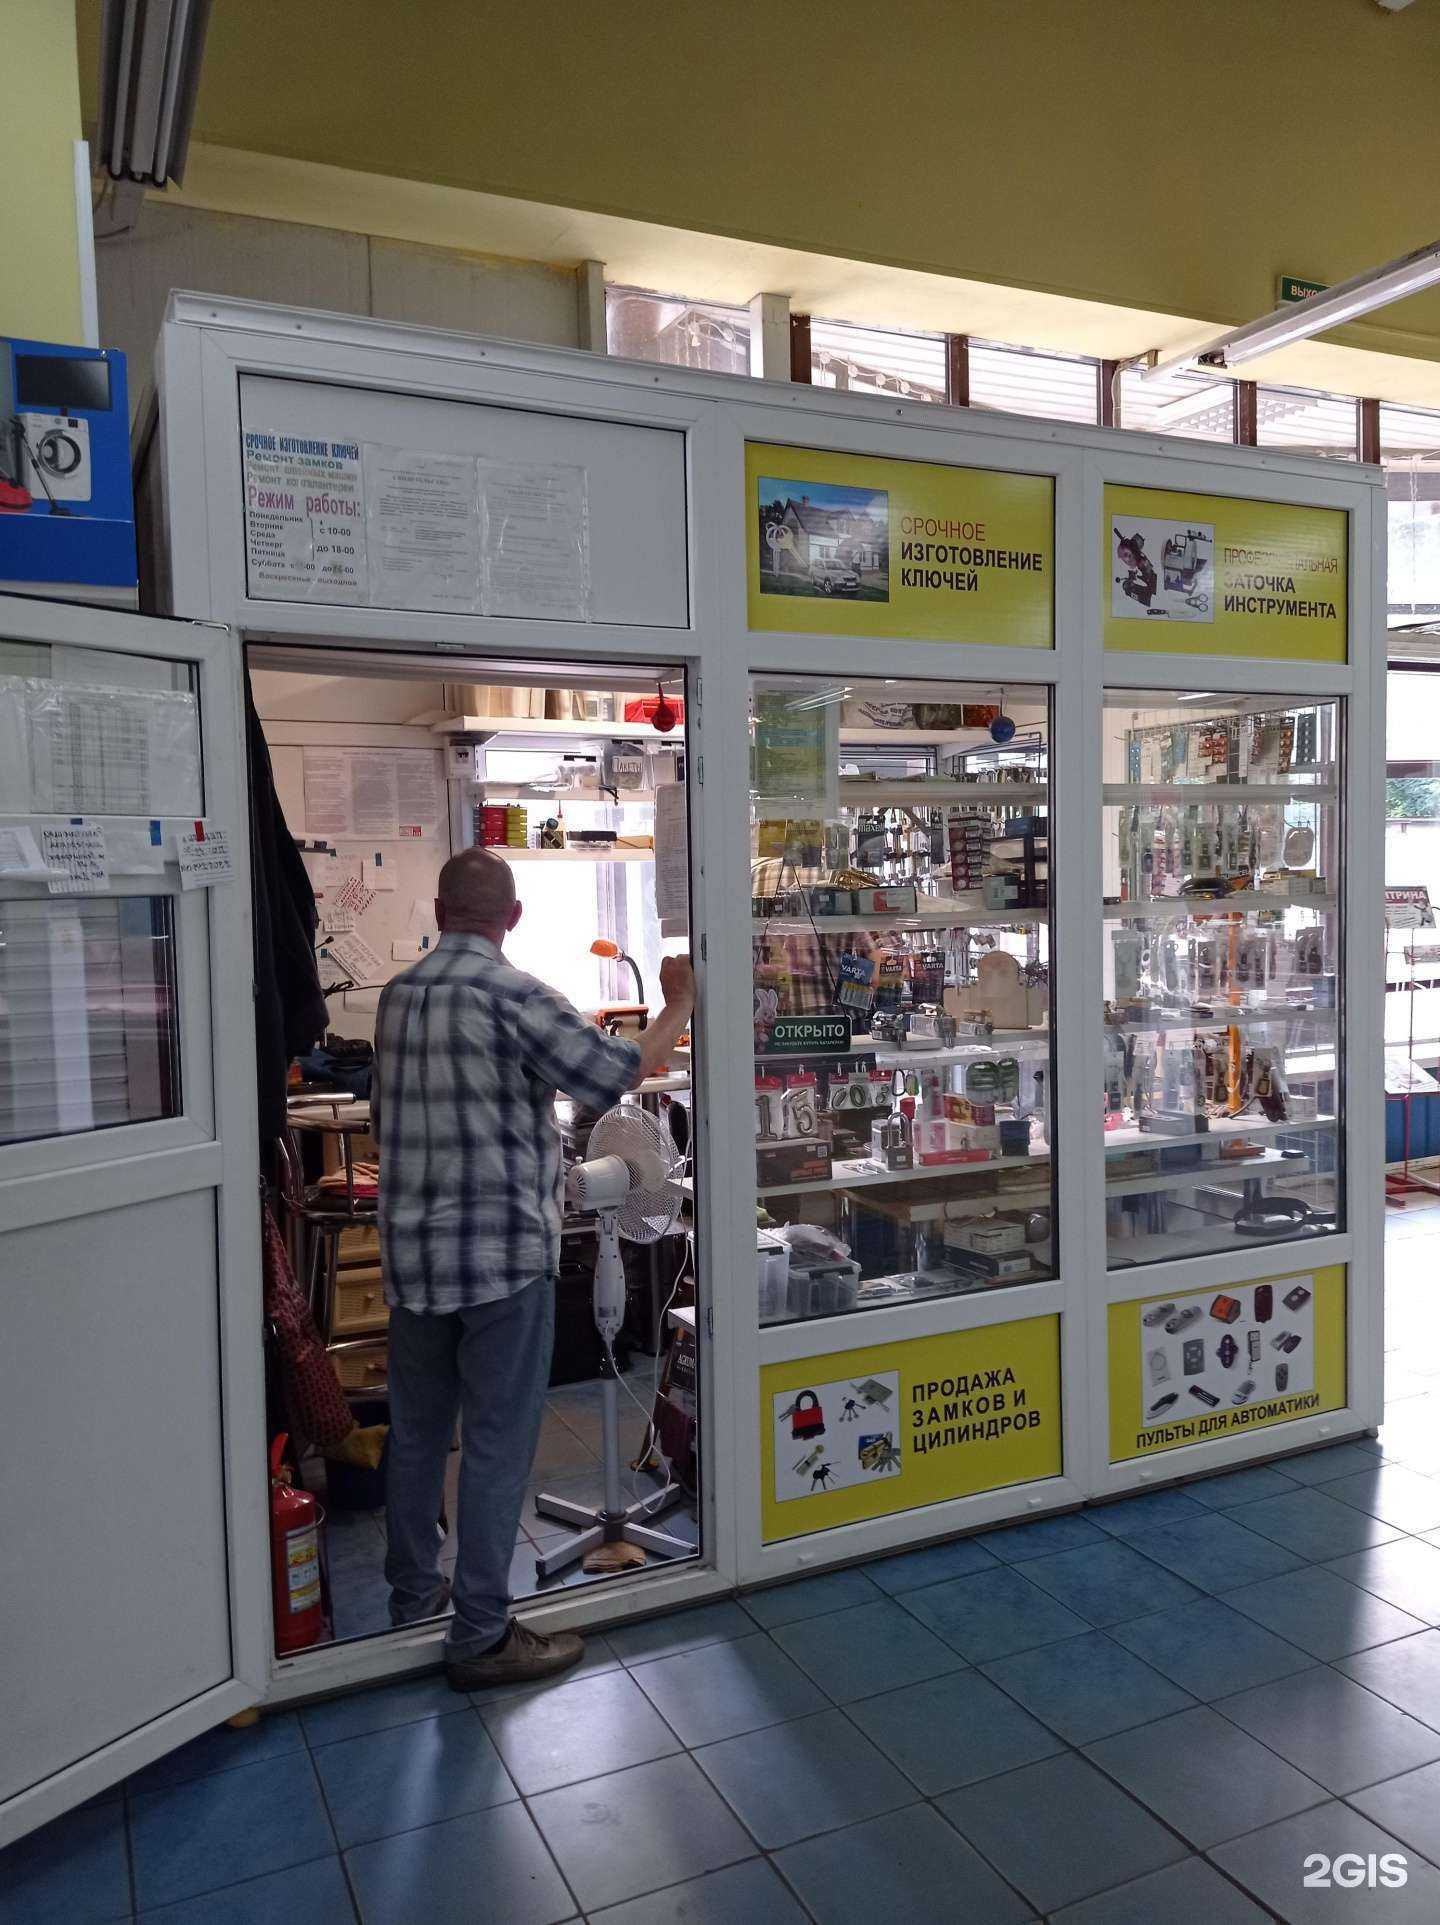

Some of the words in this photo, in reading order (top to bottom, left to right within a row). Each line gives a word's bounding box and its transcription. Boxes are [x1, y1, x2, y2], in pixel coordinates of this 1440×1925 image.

[1291, 285, 1319, 298] ВЫХО
[246, 433, 276, 451] СРОЧНОЕ
[280, 437, 329, 457] ИЗГОТОВЛЕНИЕ
[332, 443, 360, 461] КЛЮЧЕЙ
[247, 449, 294, 465] Ремонт
[298, 458, 344, 470] замков
[247, 471, 281, 486] Рмонт
[248, 484, 295, 510] Режим
[306, 492, 361, 518] работы:
[249, 511, 304, 523] Понедельник
[250, 520, 284, 530] Вторник
[328, 527, 351, 537] 10-00
[901, 516, 986, 542] СРОЧНОЕ
[250, 529, 276, 539] Среда
[250, 538, 284, 549] Четверг
[316, 544, 329, 553] до
[251, 547, 286, 557] Пятница
[901, 542, 1043, 572] ИЗГОТОВЛЕНИЕ
[251, 558, 286, 569] Суббота
[901, 568, 978, 592] КЛЮЧЕЙ
[1224, 570, 1296, 594] ЗАТОЧКА
[1224, 595, 1337, 619] ИНСТРУМЕНТА
[841, 964, 866, 978] VARTA
[885, 965, 902, 974] VARTA
[922, 961, 945, 970] VARTA
[774, 1024, 845, 1038] ОТКРЫТО
[912, 1367, 1016, 1403] ПРОДАЖА
[912, 1393, 1005, 1428] ЗАМКОВ
[1013, 1388, 1026, 1407] И
[1136, 1422, 1195, 1449] ПУЛЬТЫ
[1198, 1414, 1228, 1437] ДЛЯ
[1230, 1393, 1321, 1427] АВТОМАТИКИ
[913, 1410, 1041, 1455] ЦИЛИНДРОВ
